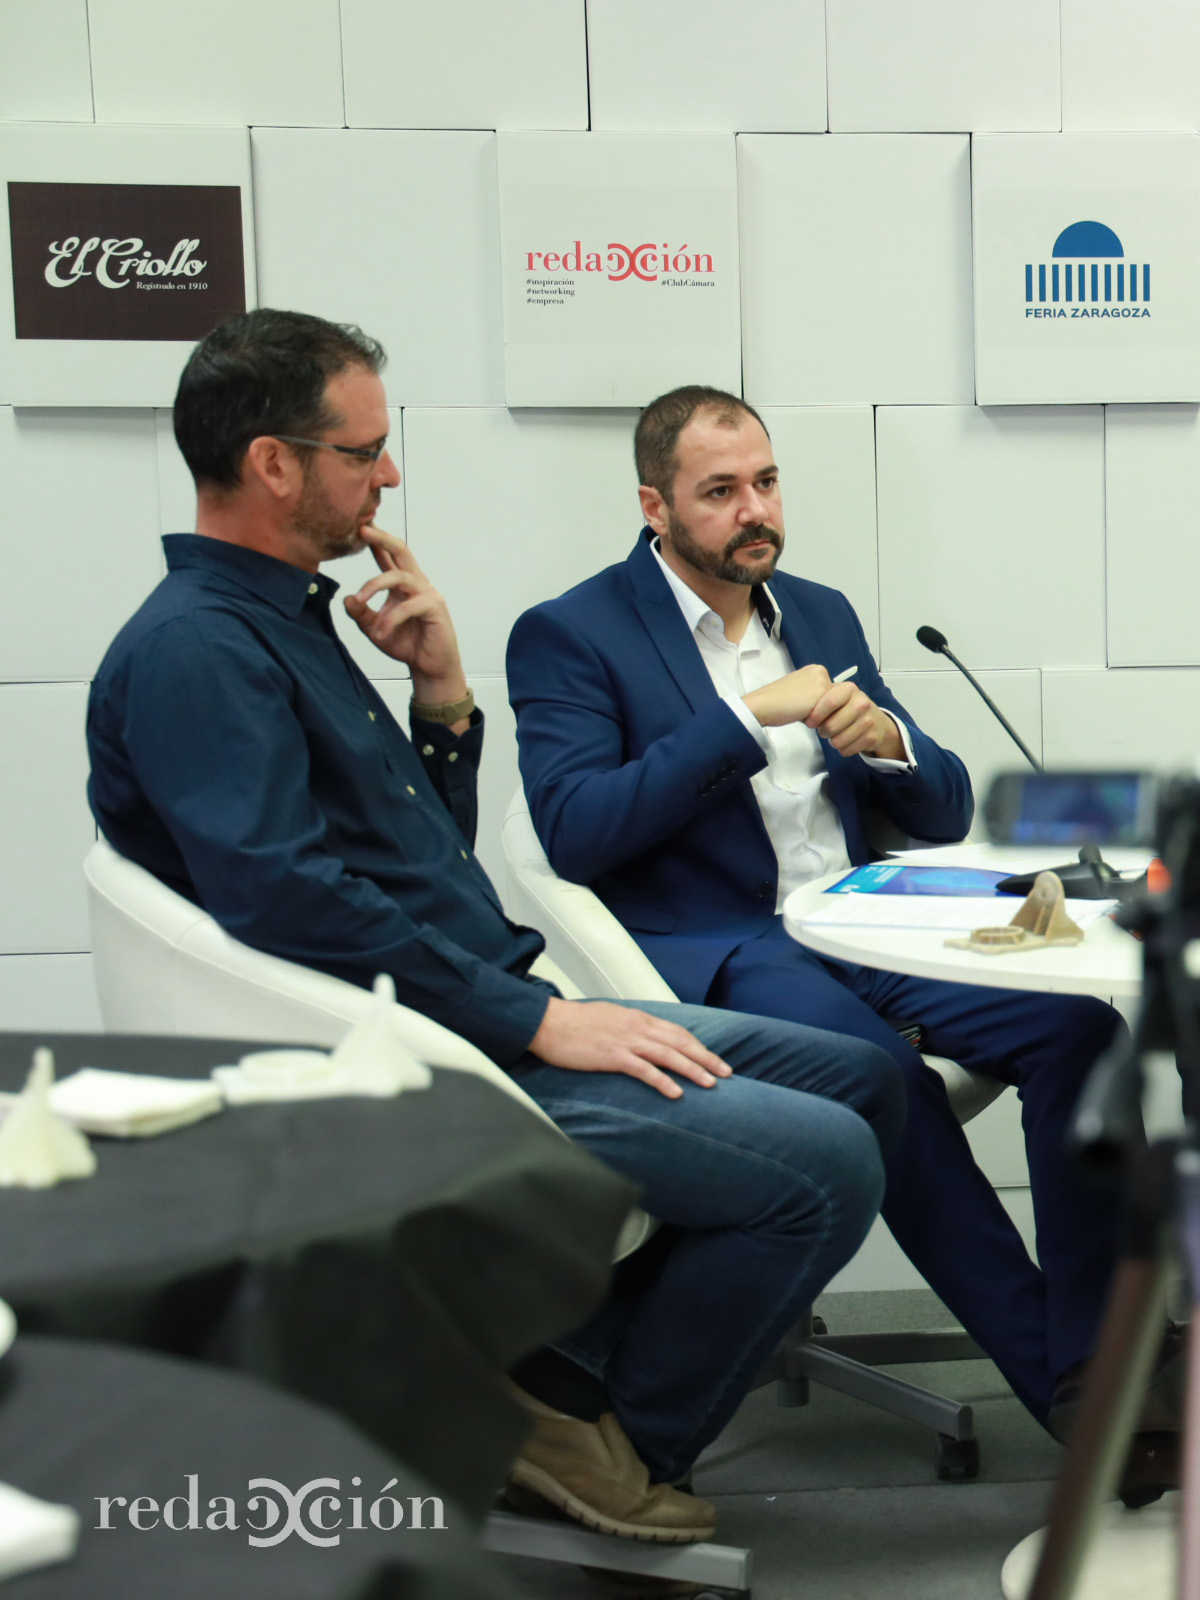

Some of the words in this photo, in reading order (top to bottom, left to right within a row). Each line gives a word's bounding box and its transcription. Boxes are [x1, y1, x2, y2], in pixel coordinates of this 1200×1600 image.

[44, 236, 101, 288] El
[96, 237, 207, 289] Criollo
[136, 281, 175, 291] Registrado
[188, 282, 208, 290] 1910
[526, 278, 575, 287] #inspiración
[661, 278, 715, 287] #ClubCámara
[526, 287, 576, 297] #networking
[526, 297, 565, 306] #empresa
[1025, 308, 1067, 318] FERIA
[1070, 308, 1151, 318] ZARAGOZA
